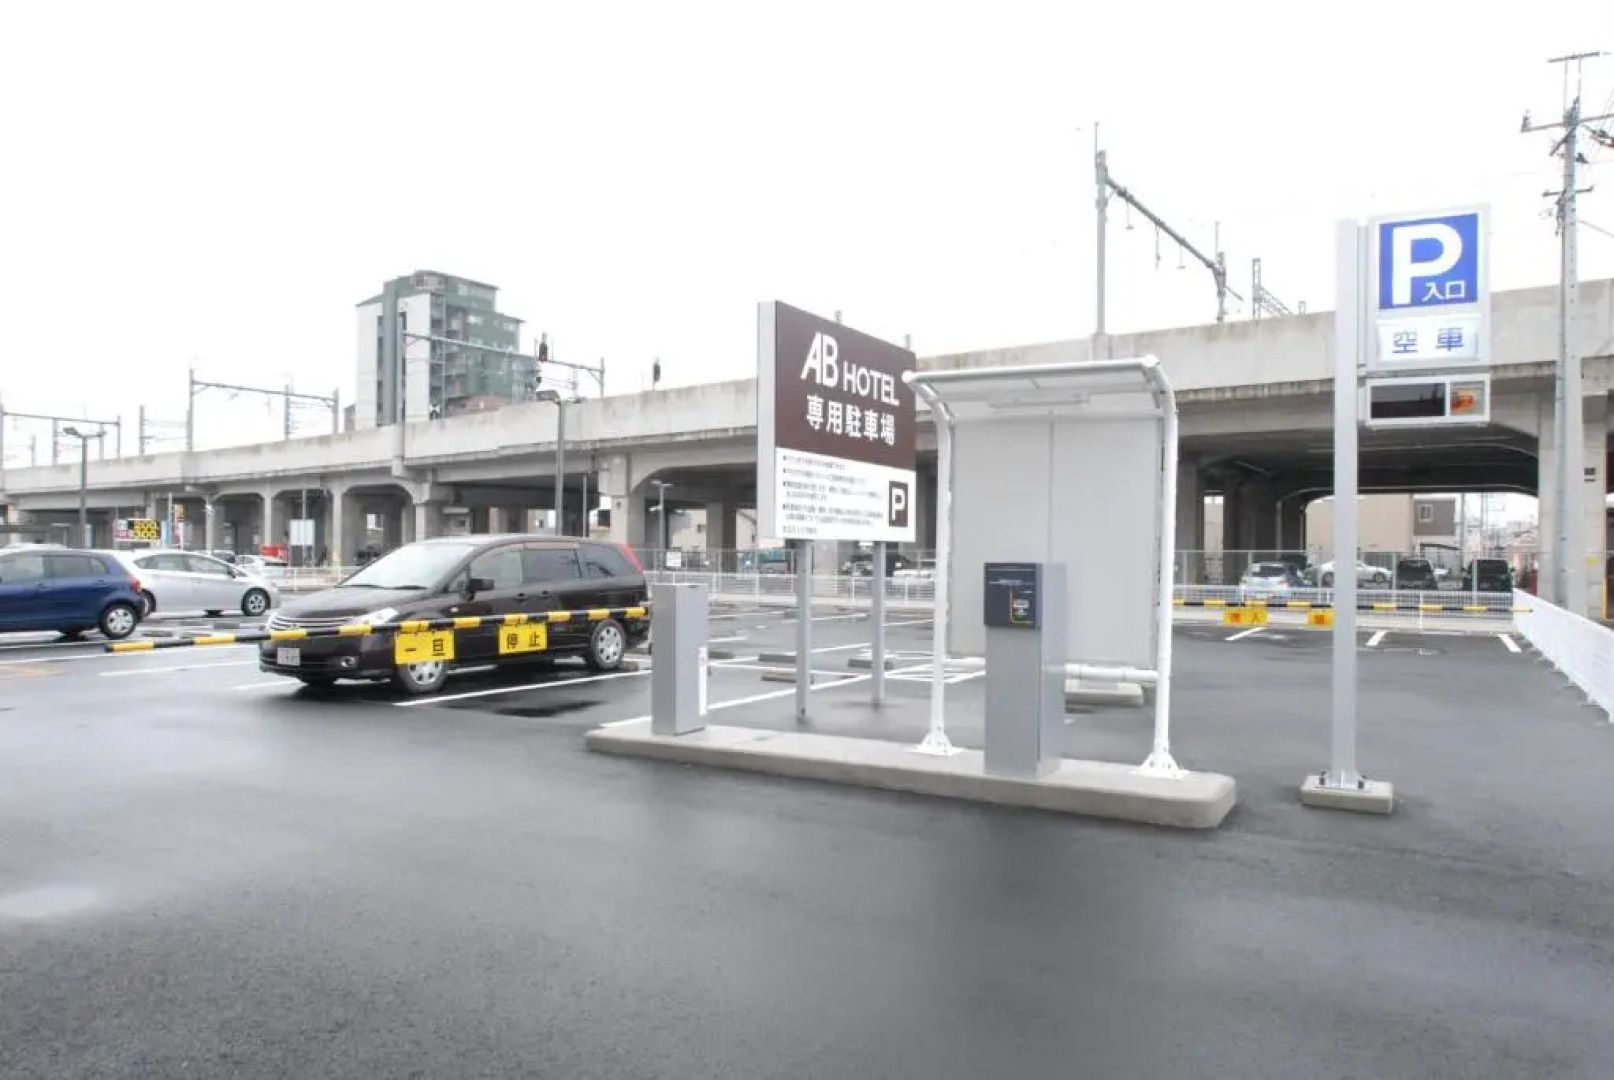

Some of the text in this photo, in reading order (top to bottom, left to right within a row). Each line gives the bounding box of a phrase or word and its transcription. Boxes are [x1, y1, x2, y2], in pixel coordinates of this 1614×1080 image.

[1392, 223, 1462, 306] P
[1422, 281, 1466, 302] 入口
[1392, 328, 1464, 353] 空車
[800, 331, 901, 406] AB HOTEL
[806, 394, 896, 446] 専用駐車場
[891, 487, 906, 521] P
[506, 632, 541, 649] 停止
